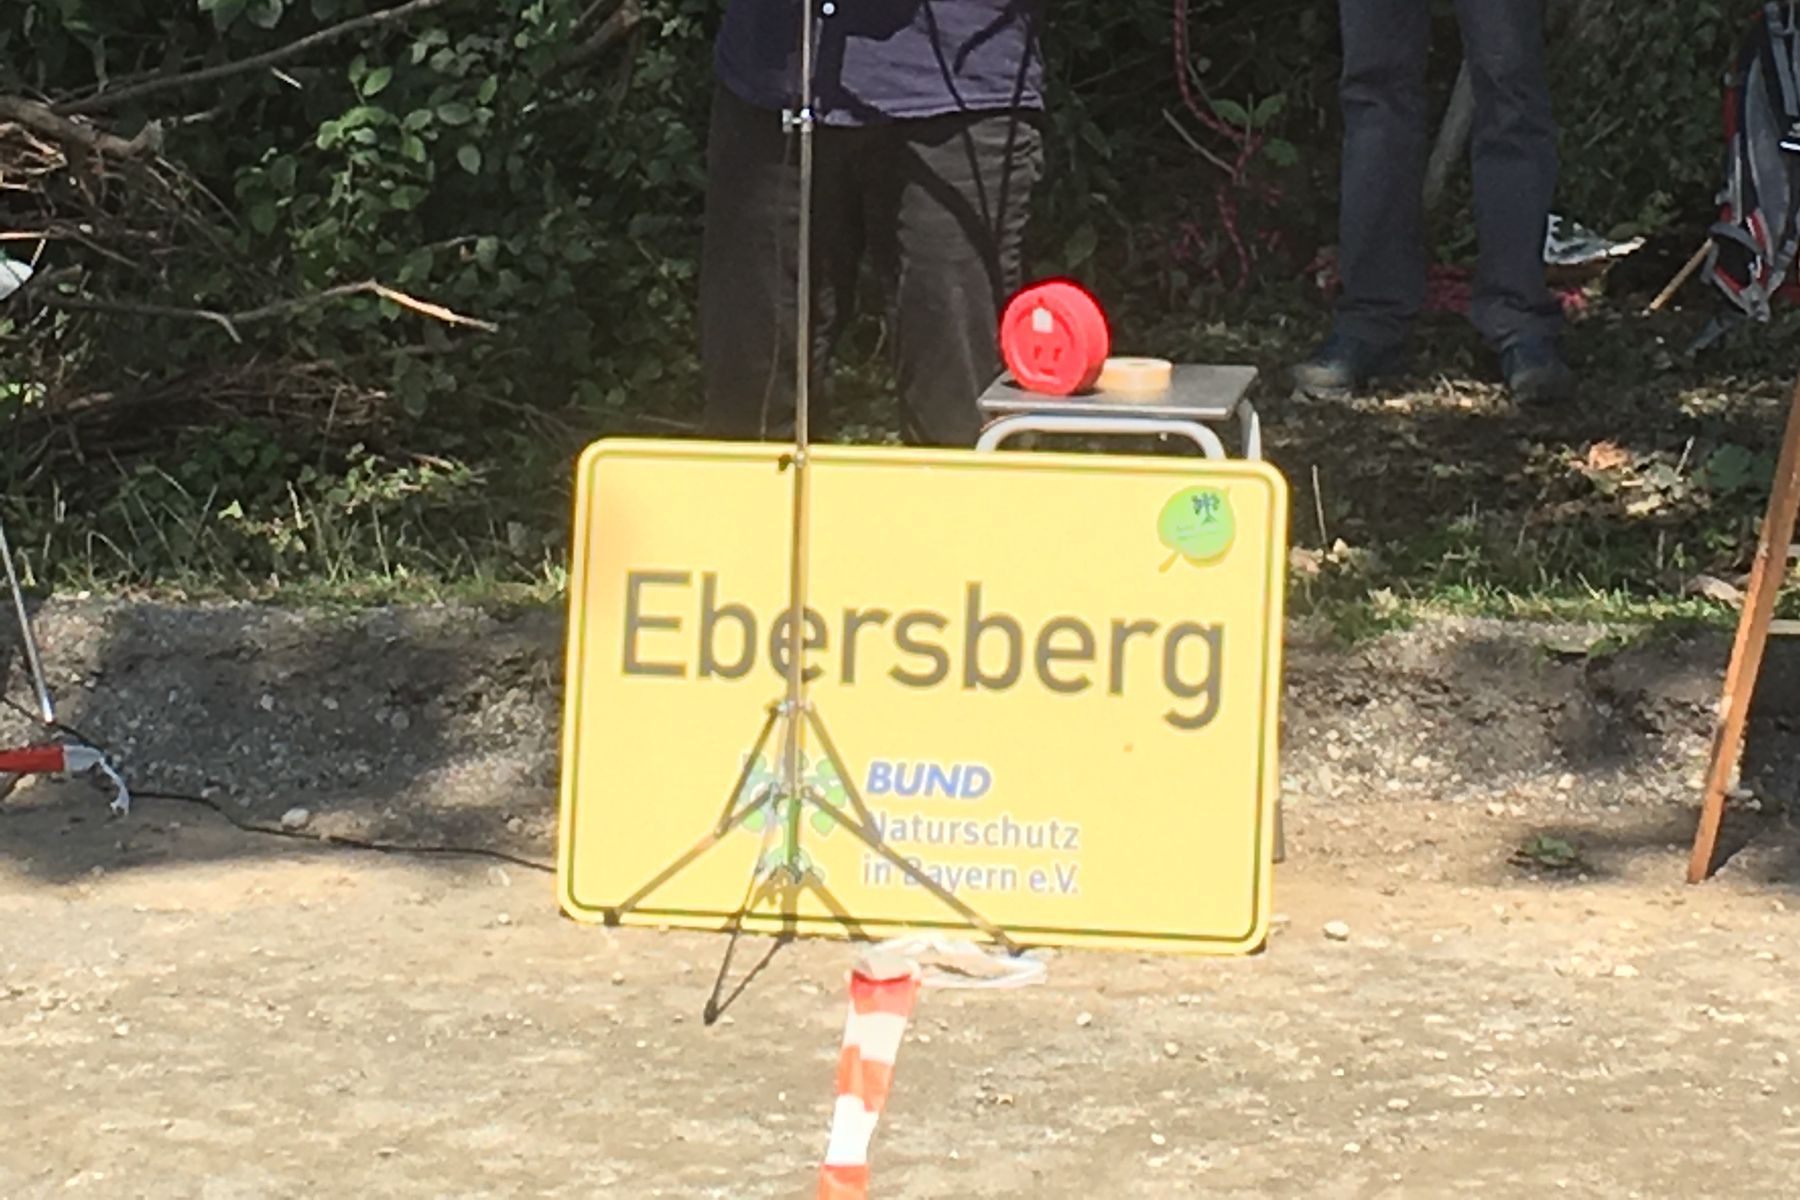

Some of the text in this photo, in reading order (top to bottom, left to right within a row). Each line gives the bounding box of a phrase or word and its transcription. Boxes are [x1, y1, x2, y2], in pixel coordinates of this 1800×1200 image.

[621, 570, 1225, 731] Ebersberg
[866, 760, 992, 799] BUND
[864, 853, 891, 885] in
[1029, 863, 1079, 894] e.V.
